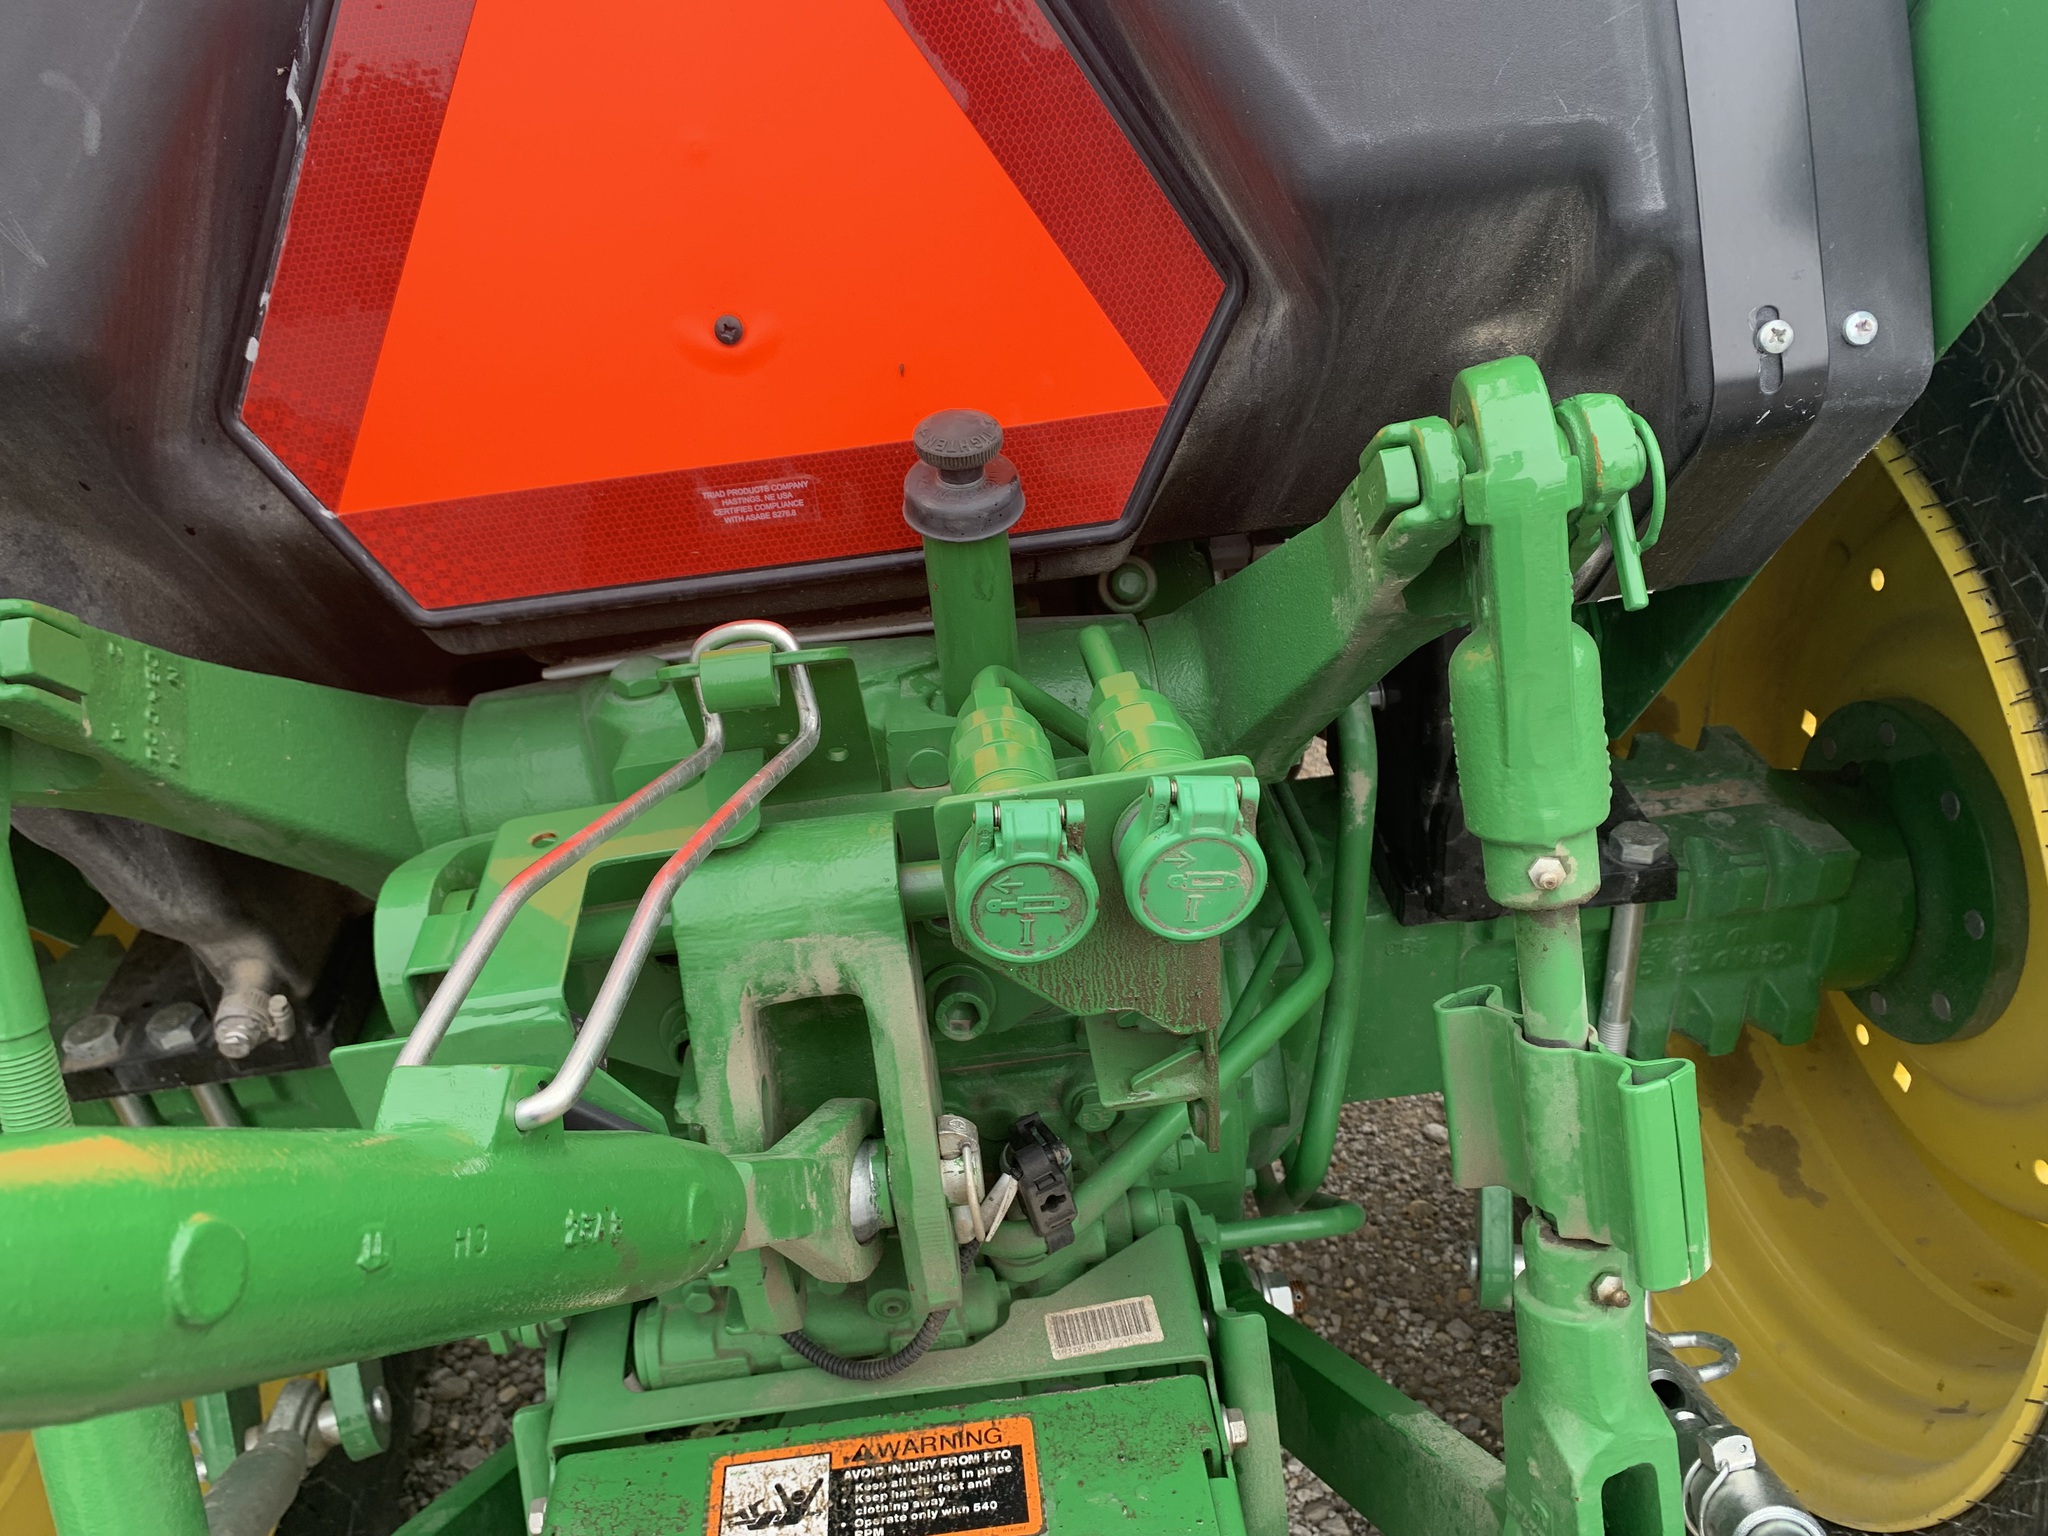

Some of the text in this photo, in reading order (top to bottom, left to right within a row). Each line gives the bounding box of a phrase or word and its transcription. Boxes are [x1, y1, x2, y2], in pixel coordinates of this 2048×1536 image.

[701, 480, 809, 500] TRIAD PRODUCTS COMPANY
[764, 493, 776, 502] NE
[776, 491, 794, 500] USA
[713, 499, 805, 517] CERTIFIES COMPLIANCE
[723, 515, 746, 524] WITH
[745, 511, 772, 521] ASABE
[877, 1427, 1003, 1459] WARNING
[844, 1449, 1012, 1480] AVOID INJURY FROM PTO
[854, 1464, 1013, 1493] Keep all shields in place
[854, 1492, 888, 1505] Keep
[937, 1482, 965, 1493] feet
[967, 1477, 992, 1489] and
[854, 1500, 998, 1529] Operate only with 540
[855, 1496, 946, 1516] clothing away
[854, 1526, 885, 1536] RPM
